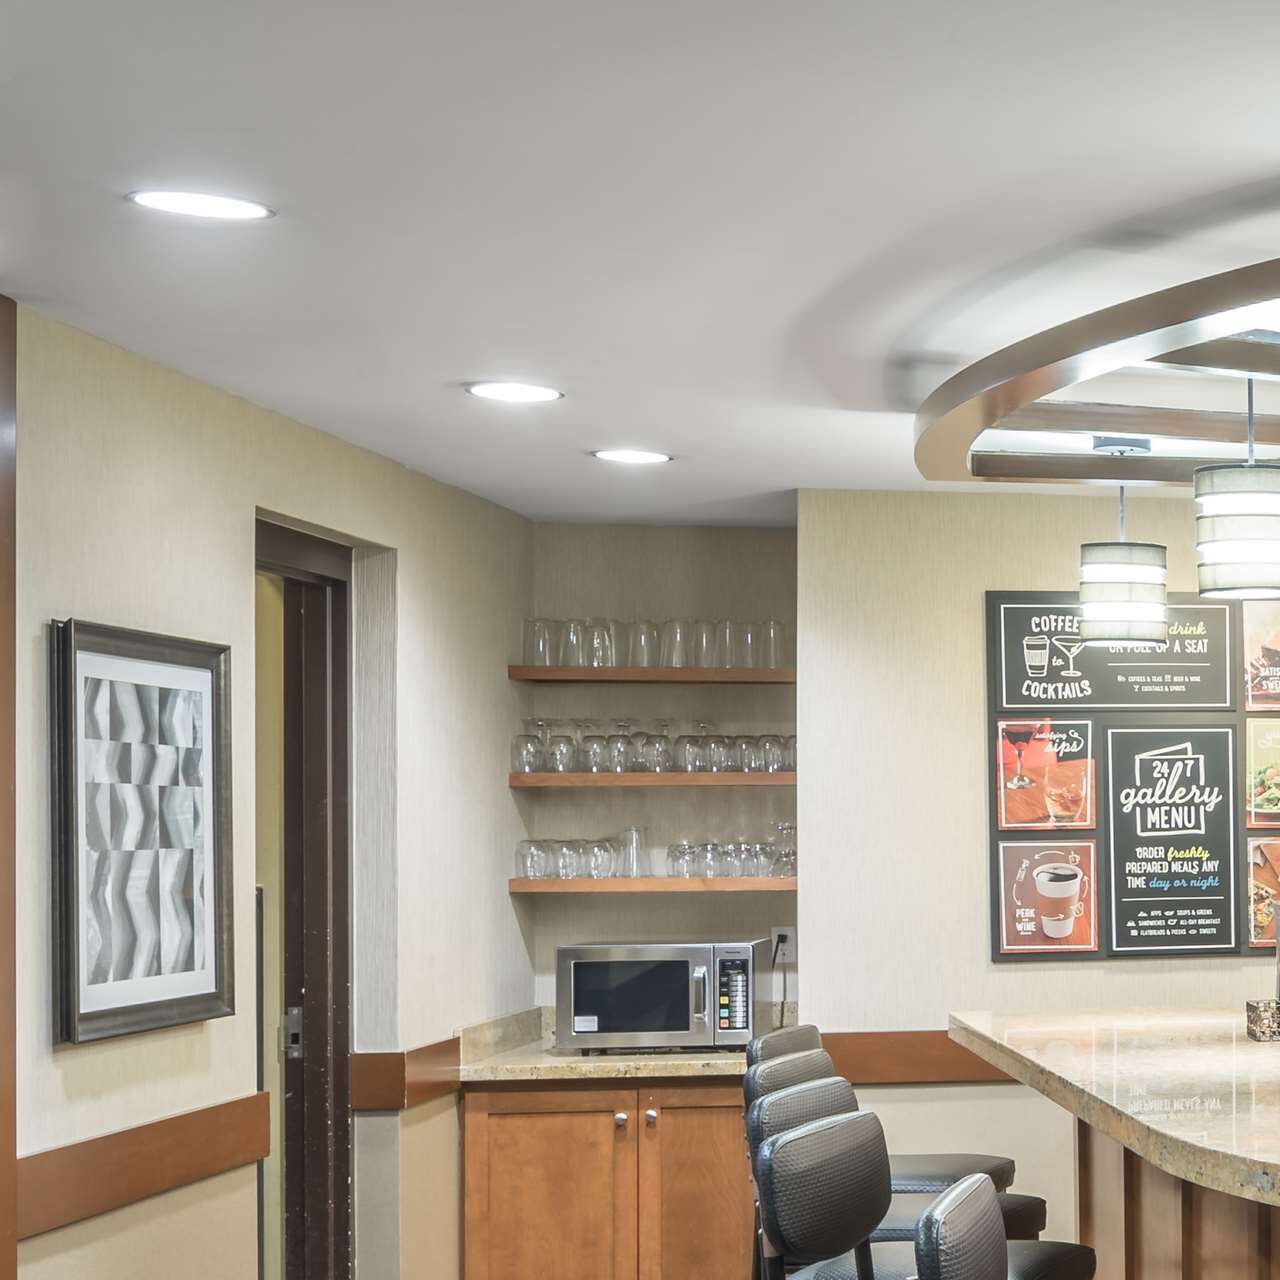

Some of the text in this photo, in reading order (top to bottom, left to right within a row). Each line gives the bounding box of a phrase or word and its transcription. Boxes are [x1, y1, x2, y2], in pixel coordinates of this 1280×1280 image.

[1031, 615, 1080, 632] COFFEE
[1169, 622, 1207, 636] drink
[1174, 640, 1181, 653] A
[1185, 639, 1208, 653] SEAT
[1051, 655, 1064, 666] to
[1022, 679, 1092, 699] COCKTAILS
[1043, 739, 1084, 757] sips
[1120, 760, 1222, 813] gallery
[1147, 805, 1196, 829] MENU
[1136, 846, 1210, 862] ORDER freshly
[1125, 860, 1219, 874] PREPARED MEALS ANY
[1126, 875, 1220, 891] TIME day or night
